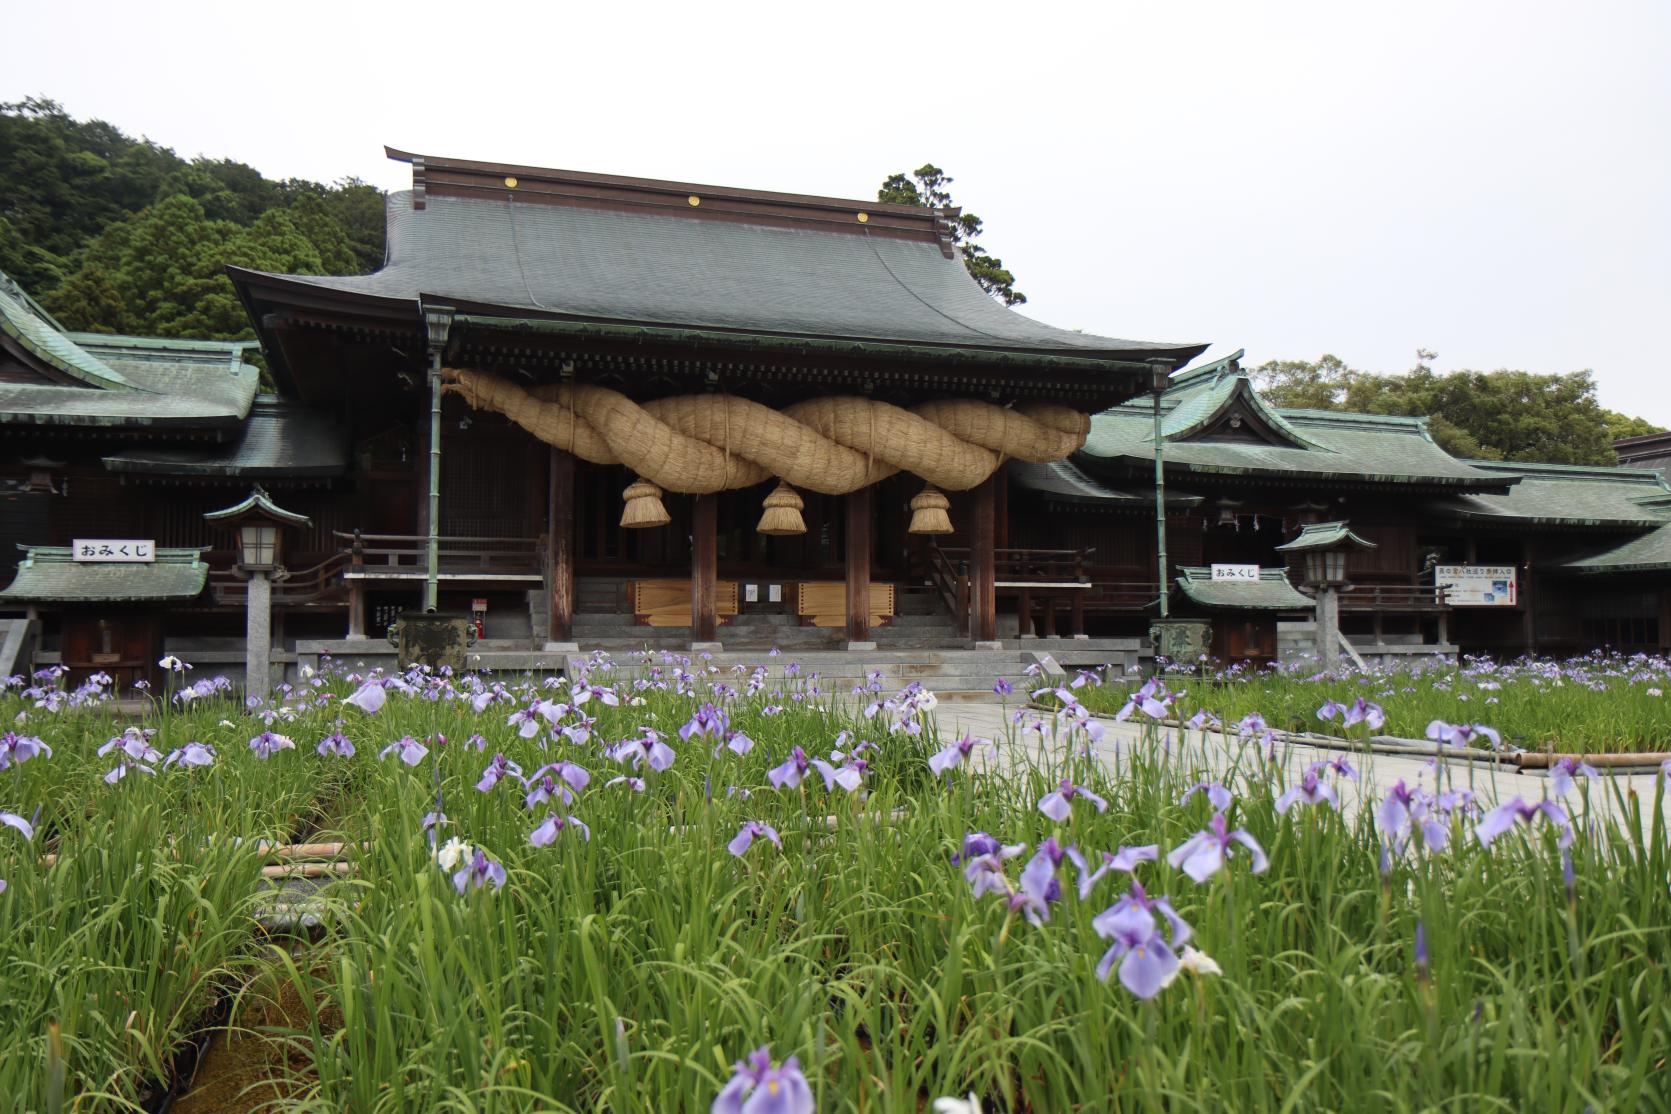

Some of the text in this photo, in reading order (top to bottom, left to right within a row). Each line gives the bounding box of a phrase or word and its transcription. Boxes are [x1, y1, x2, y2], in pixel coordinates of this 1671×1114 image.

[81, 545, 147, 556] おみくじ
[1216, 568, 1255, 578] おみくじ
